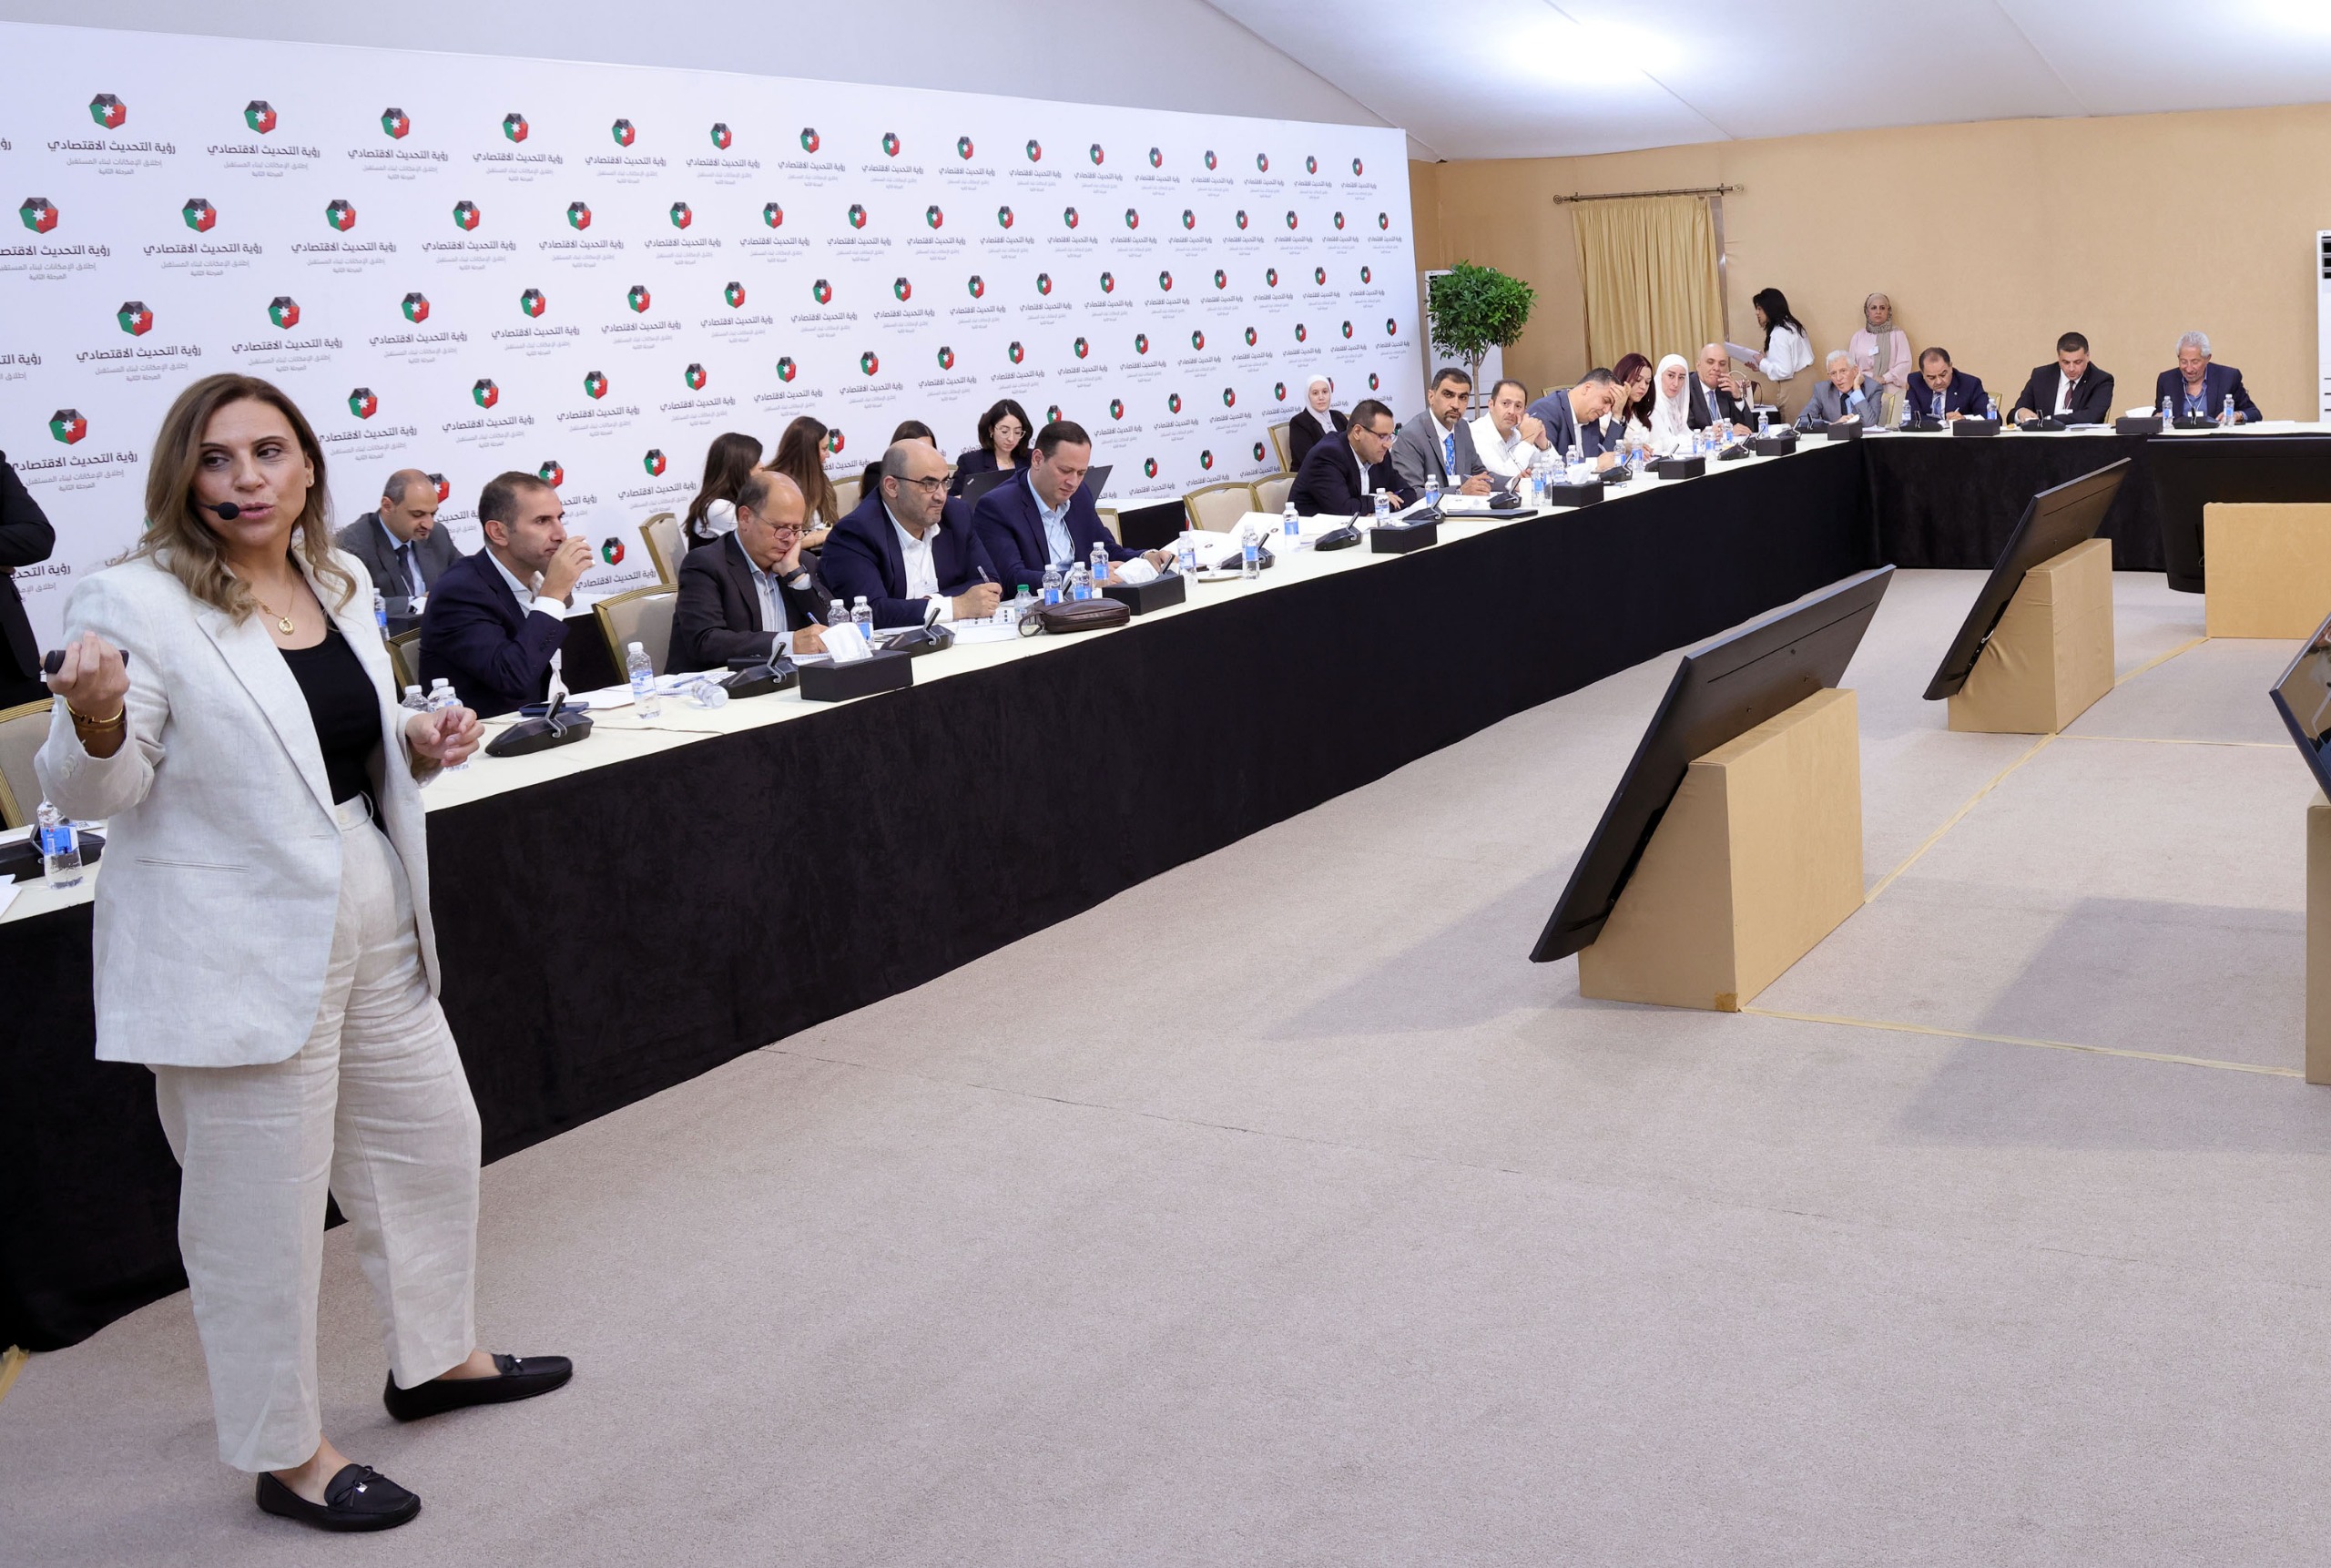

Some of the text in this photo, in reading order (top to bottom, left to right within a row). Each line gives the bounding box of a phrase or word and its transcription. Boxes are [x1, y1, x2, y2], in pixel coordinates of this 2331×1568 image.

[1, 137, 12, 150] رؤ
[47, 139, 176, 154] رؤية التحديث الاقتصادي
[207, 144, 321, 158] رؤية التحديث الاقتصادي
[348, 148, 449, 161] رؤية التحديث الاقتصادي
[473, 152, 564, 164] رؤية التحديث الاقتصادي
[585, 156, 667, 167] رؤية التحديث الاقتصادي
[687, 158, 760, 169] رؤية التحديث الاقتصادي
[779, 161, 846, 172] رؤية التحديث الاقتصادي
[291, 242, 397, 254] رؤية التحديث الاقتصادي
[422, 240, 516, 252] رؤية التحديث الاقتصادي
[539, 239, 625, 250] رؤية التحديث الاقتصادي
[645, 239, 722, 249] رؤية التحديث الاقتصادي
[740, 238, 810, 248] رؤية التحديث الاقتصادي
[0, 245, 110, 258] رؤية التحديث الاقتص
[143, 243, 262, 257] رؤية التحديث الاقتصادي
[701, 315, 774, 329] رؤية التحديث الاقتصادي
[791, 311, 858, 323] رؤية التحديث الاقتصادي
[492, 325, 580, 340] رؤية التحديث الاقتصادي
[602, 321, 682, 334] رؤية التحديث الاقتصادي
[370, 331, 468, 347] رؤية التحديث الاقتصادي
[231, 338, 342, 354] رؤية التحديث الاقتصادي
[18, 352, 42, 365] رؤية
[76, 345, 201, 362] رؤية التحديث الاقتصادي
[754, 389, 823, 403] رؤية التحديث الاقتصادي
[660, 396, 736, 412] رؤية التحديث الاقتصادي
[557, 405, 640, 423] رؤية التحديث الاقتصادي
[400, 425, 417, 436] رؤية
[443, 415, 534, 433] رؤية التحديث الاقتصادي
[363, 427, 398, 440] التحديث
[69, 453, 113, 467] التحديث
[116, 451, 137, 463] رؤية
[836, 459, 859, 470] التحديث
[618, 481, 697, 500] رؤية التحديث الاقتصادي
[561, 494, 597, 507] رؤية التحد
[436, 508, 479, 524] ية التحديث
[10, 562, 70, 580] رؤية التحدي
[575, 568, 657, 591] رؤية التحديث الاقتصادي
